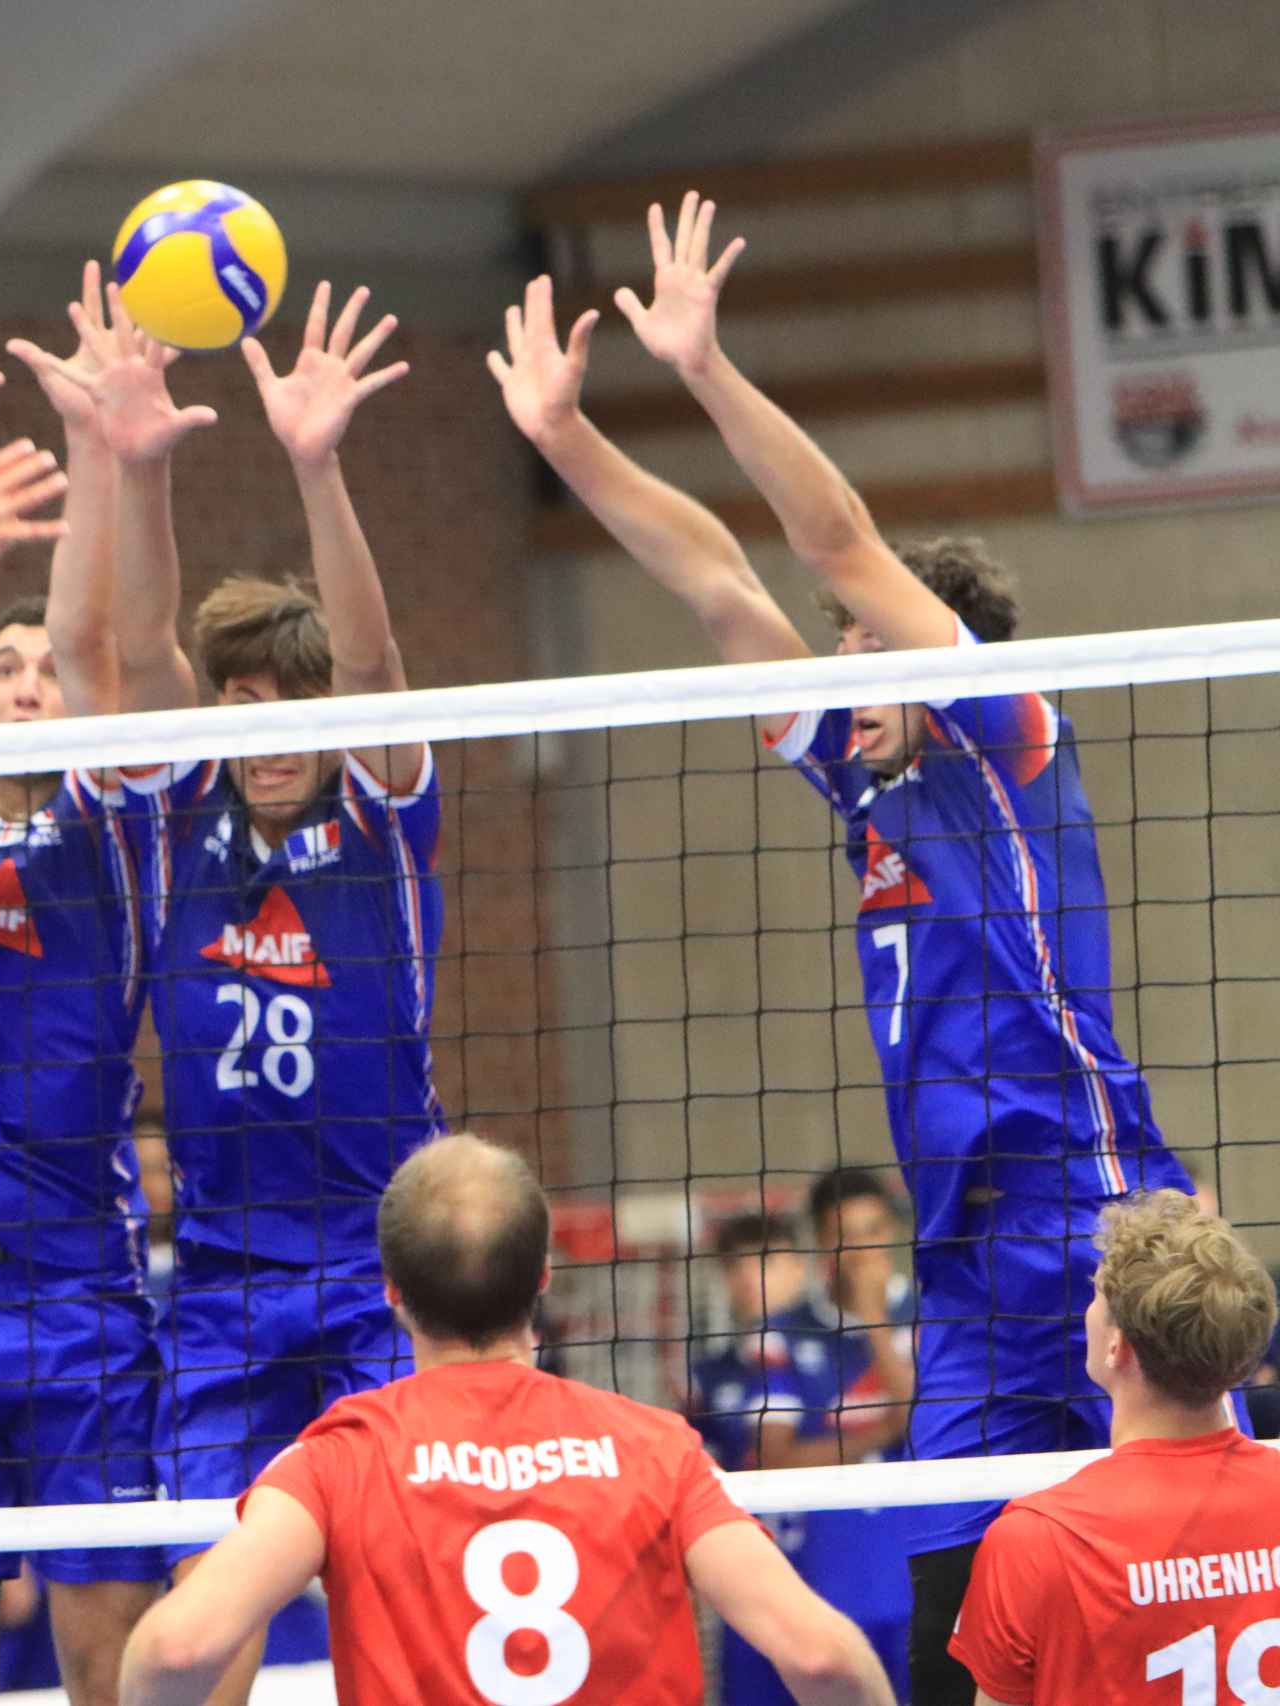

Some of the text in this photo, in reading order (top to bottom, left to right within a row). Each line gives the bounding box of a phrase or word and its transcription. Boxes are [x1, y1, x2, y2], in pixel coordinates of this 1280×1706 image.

[222, 923, 312, 965] MAIF
[872, 923, 908, 1045] 7
[215, 983, 315, 1098] 28
[407, 1435, 619, 1491] JACOBSEN
[463, 1519, 591, 1706] 8
